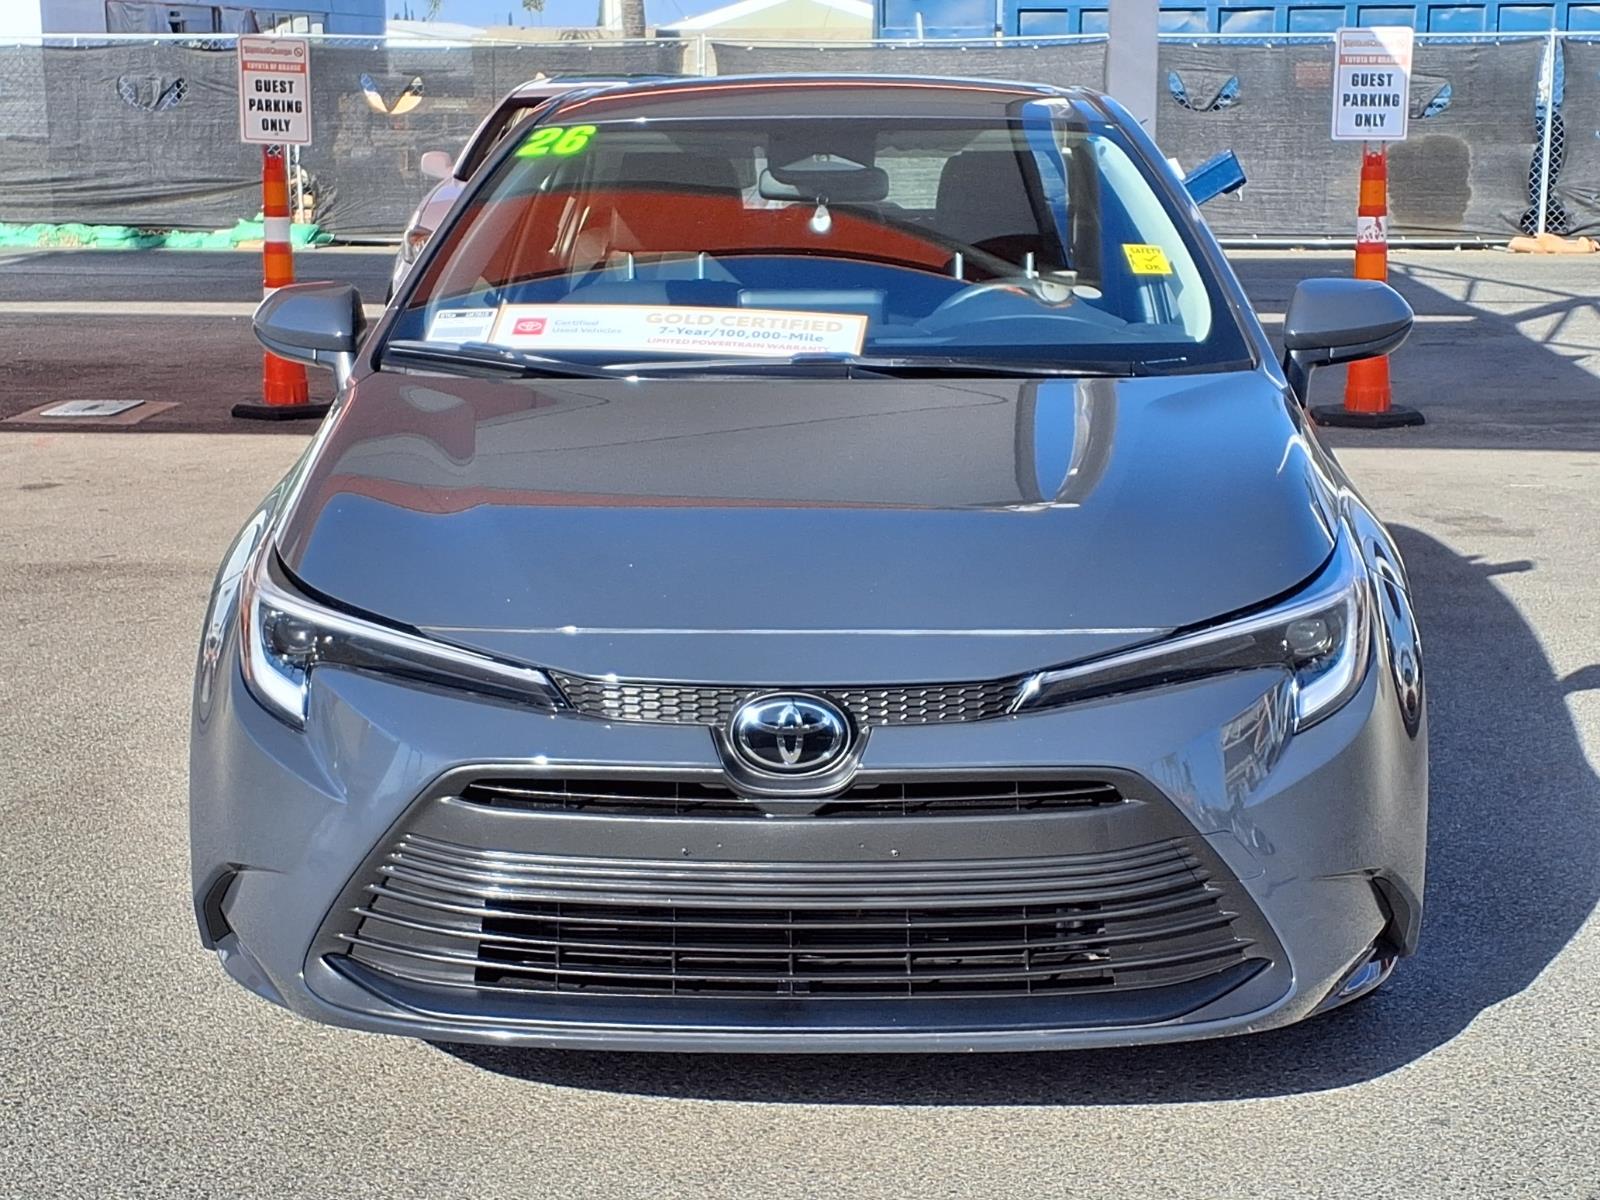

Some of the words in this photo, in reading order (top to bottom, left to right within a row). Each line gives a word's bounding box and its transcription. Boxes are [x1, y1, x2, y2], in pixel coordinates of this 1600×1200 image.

[1344, 55, 1368, 64] TOYOTA
[1369, 56, 1377, 64] OF
[255, 79, 294, 94] GUEST
[1351, 73, 1393, 87] GUEST
[248, 98, 302, 114] PARKING
[1342, 93, 1400, 107] PARKING
[261, 118, 291, 132] ONLY
[1355, 113, 1386, 127] ONLY
[513, 125, 597, 156] 26
[1130, 247, 1161, 255] SAFETY
[646, 312, 714, 326] GOLD
[720, 315, 843, 333] CERTIFIED
[659, 326, 824, 343] 7-Year/100,000-Mile
[646, 337, 690, 345] LIMITED
[692, 338, 765, 349] POWERTRAIN
